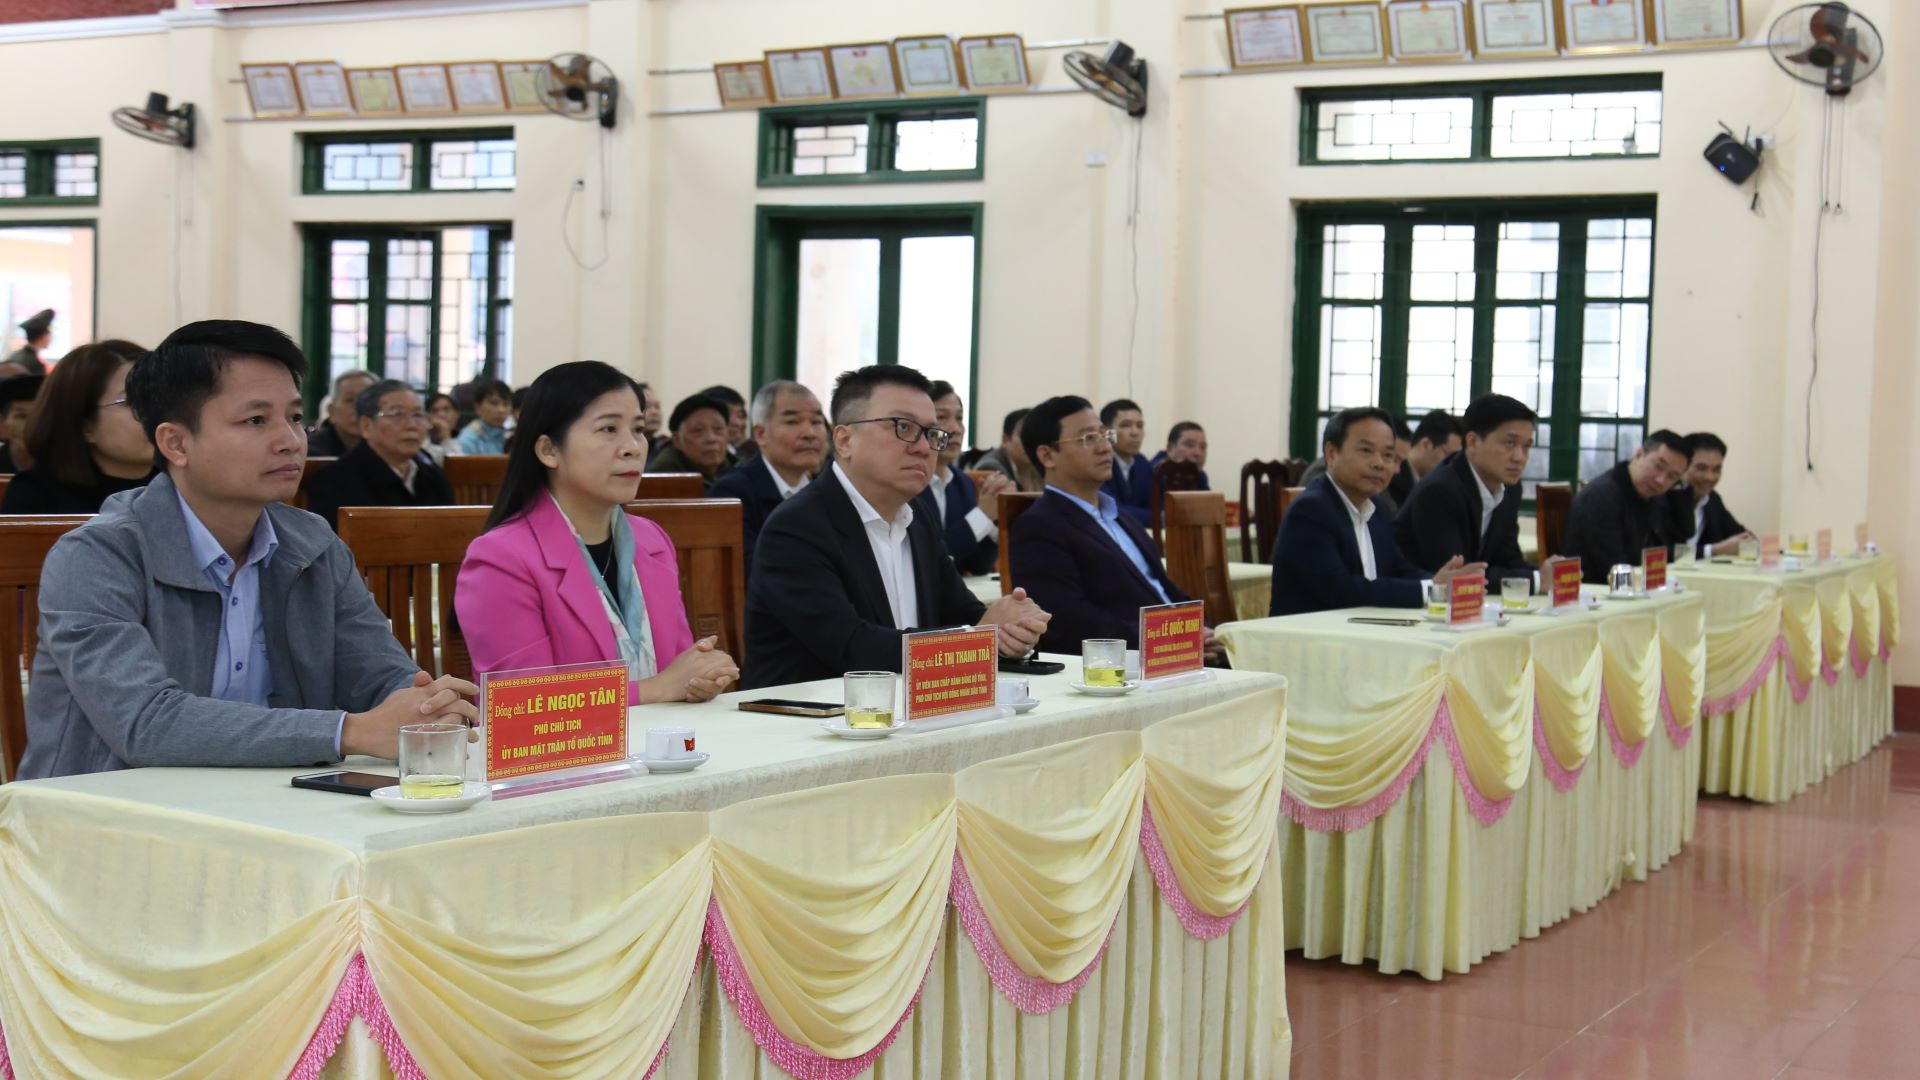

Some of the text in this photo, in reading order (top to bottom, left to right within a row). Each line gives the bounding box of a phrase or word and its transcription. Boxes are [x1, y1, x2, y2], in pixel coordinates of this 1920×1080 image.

[1162, 620, 1168, 637] LÊ
[1170, 616, 1184, 637] QUỐC
[935, 650, 943, 667] LÊ
[944, 651, 954, 667] THỊ
[956, 649, 977, 664] THANH
[495, 702, 513, 718] Đồng
[527, 694, 543, 714] LÊ
[547, 692, 585, 712] NGỌC
[590, 687, 616, 706] TÂN
[534, 717, 582, 735] PHÓ CHỦ TỊCH
[502, 732, 613, 759] ỦY BAN MẶT TRẬN TỔ QUỐC TỈNH
